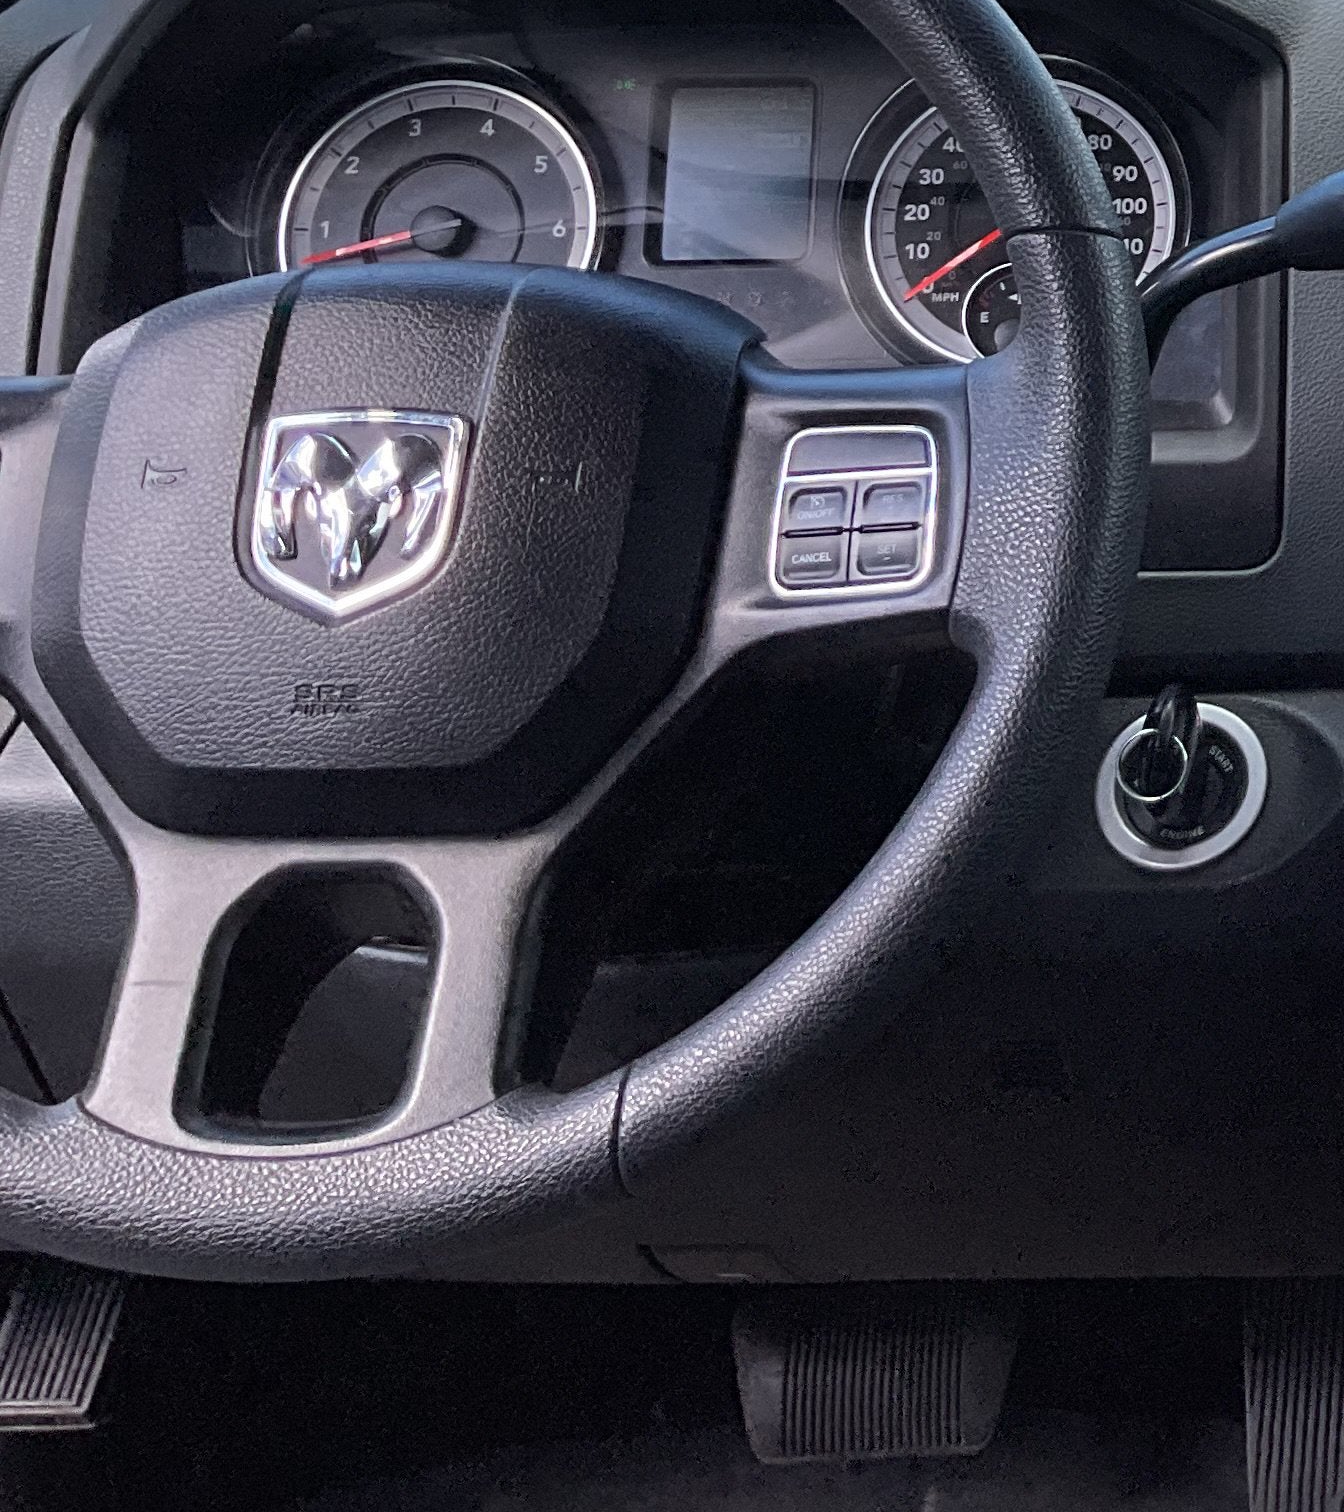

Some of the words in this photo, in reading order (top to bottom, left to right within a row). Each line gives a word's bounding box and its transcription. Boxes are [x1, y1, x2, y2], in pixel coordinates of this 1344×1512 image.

[408, 119, 422, 137] 3
[479, 119, 495, 137] 4
[1088, 134, 1112, 151] 80
[344, 156, 360, 175] 2
[534, 155, 548, 175] 5
[1112, 165, 1138, 182] 90
[919, 168, 944, 185] 30
[930, 196, 945, 206] 40
[1112, 197, 1147, 215] 100
[904, 204, 930, 221] 20
[320, 221, 330, 238] 1
[552, 219, 566, 238] 6
[926, 231, 941, 241] 20
[905, 242, 930, 259] 10
[1122, 238, 1144, 255] 10
[931, 291, 960, 302] MPH
[980, 311, 990, 323] E
[796, 507, 834, 520] ON/OFF
[876, 543, 897, 555] SET
[791, 551, 832, 565] CANCEL
